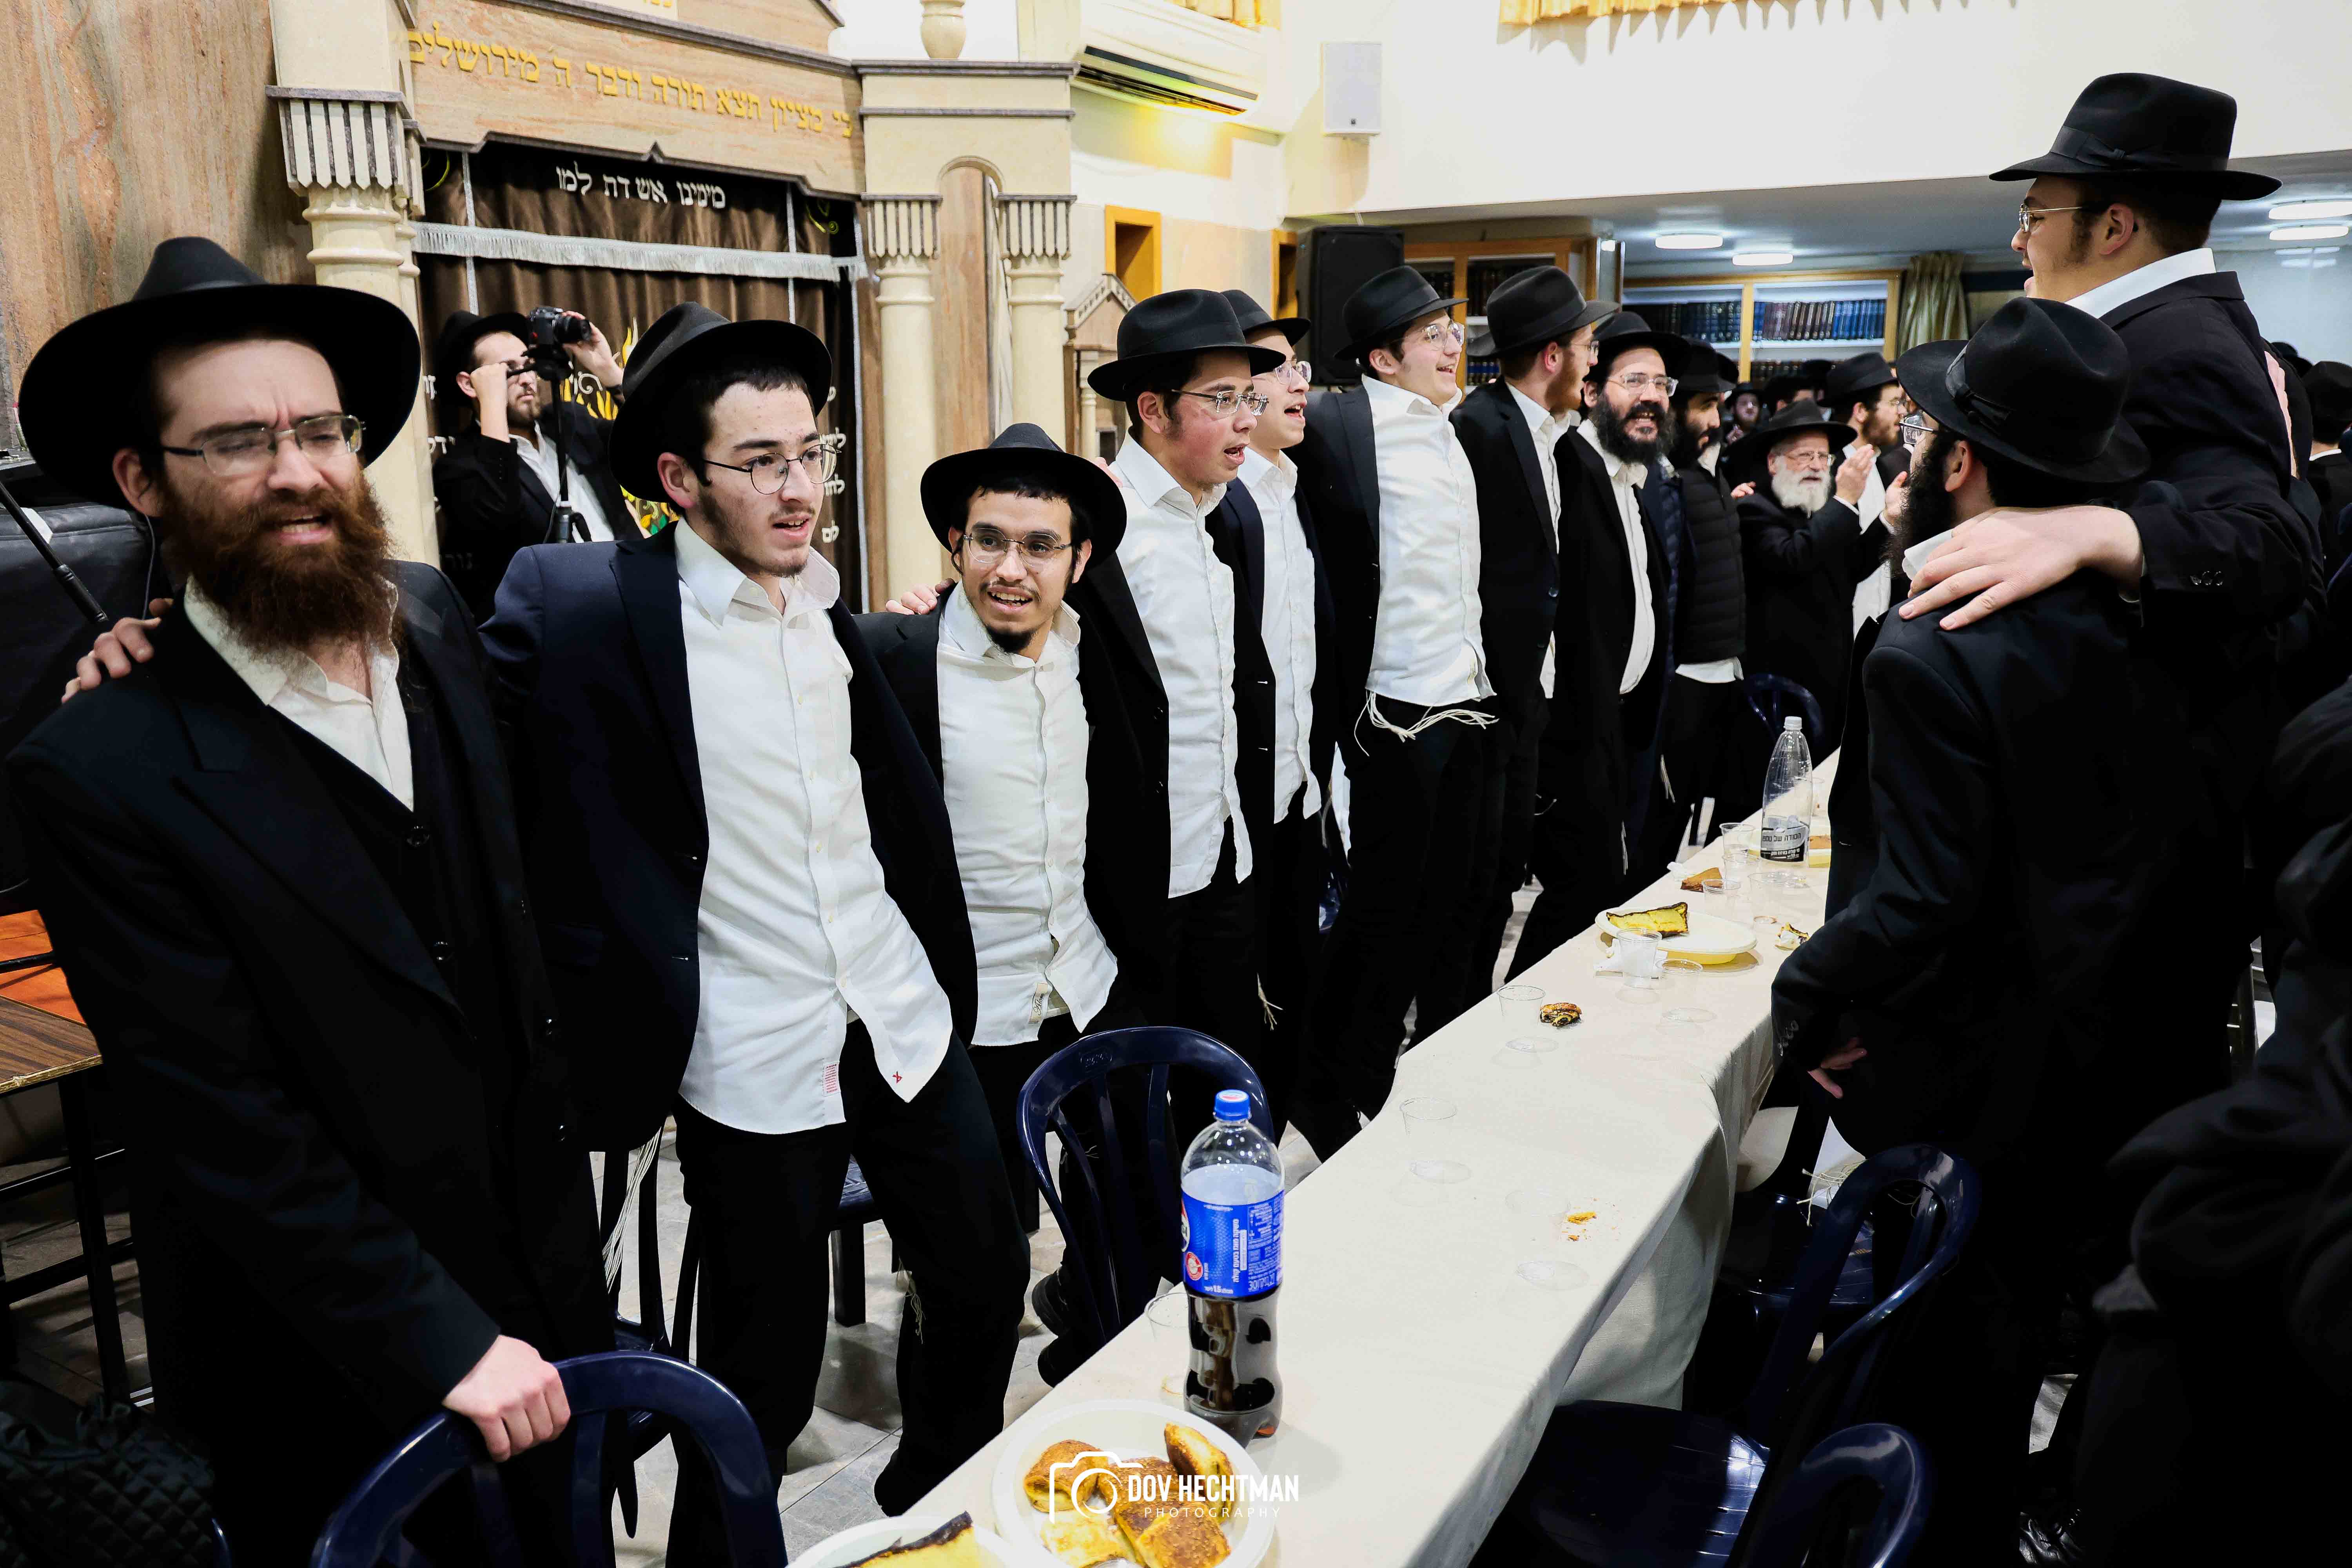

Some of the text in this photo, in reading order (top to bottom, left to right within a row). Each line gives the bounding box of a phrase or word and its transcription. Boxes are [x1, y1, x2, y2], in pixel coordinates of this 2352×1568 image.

[408, 20, 539, 83] מירושלים
[586, 62, 642, 101] ודבר
[651, 75, 706, 111] תורה
[716, 89, 761, 120] תצא
[769, 96, 823, 133] מציון
[832, 110, 853, 138] כי
[556, 160, 592, 196] למו
[603, 174, 630, 199] דת
[635, 177, 668, 204] אש
